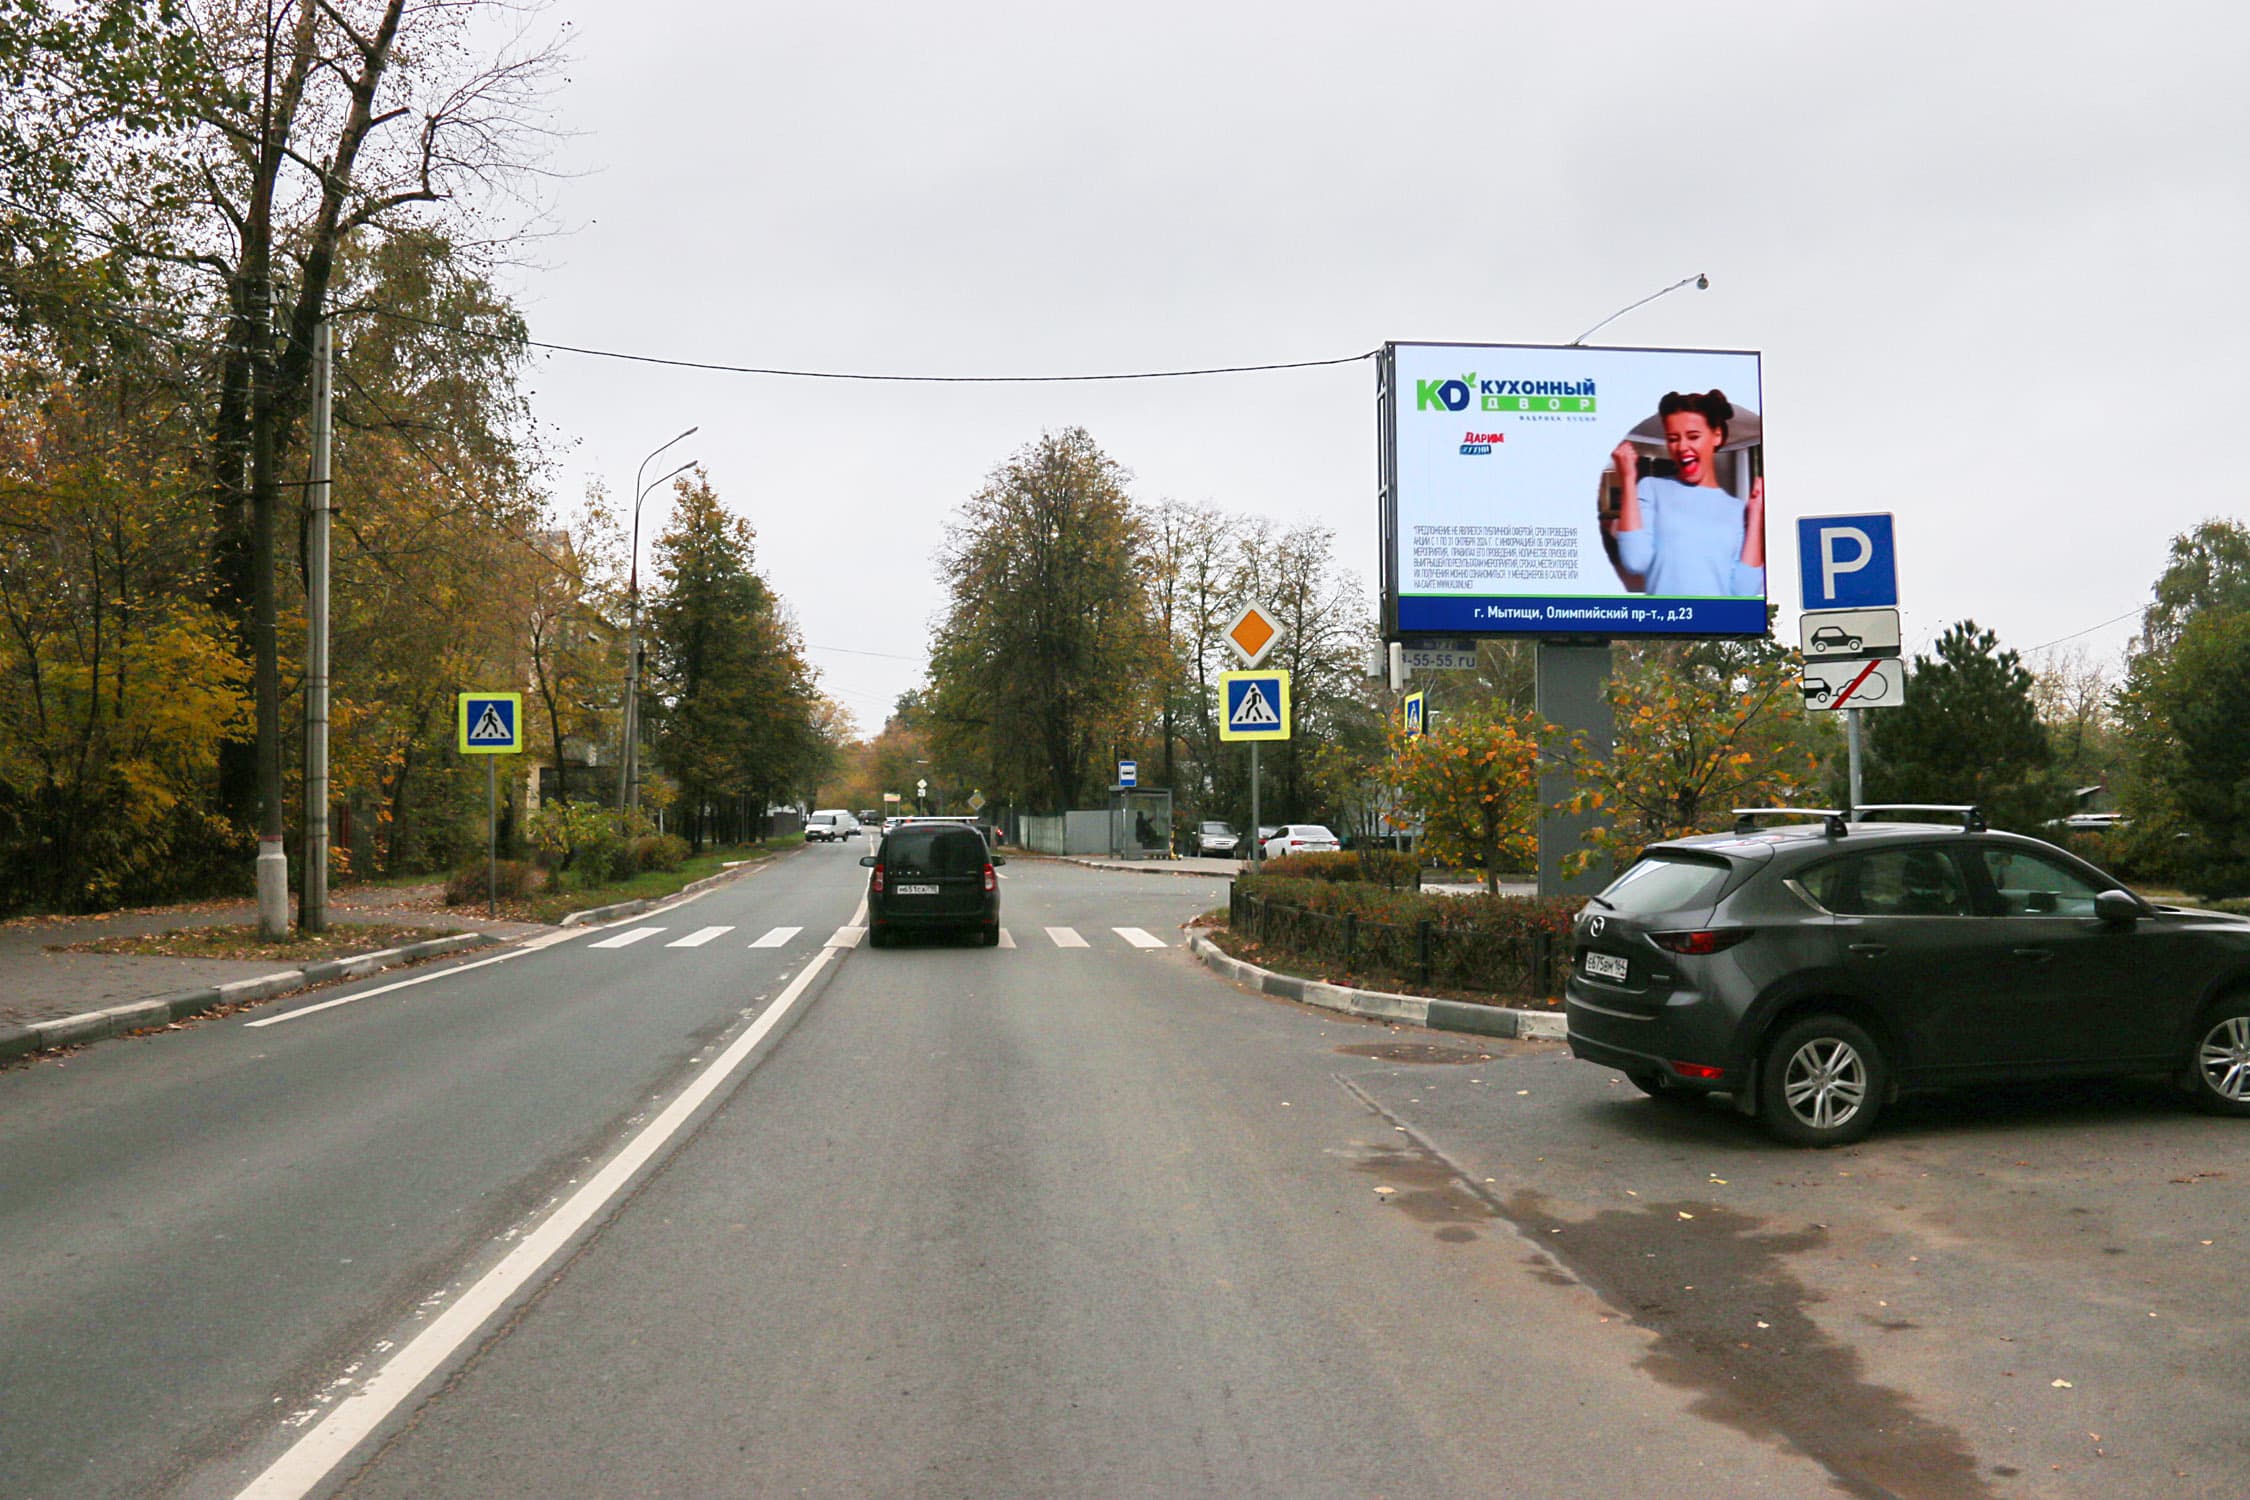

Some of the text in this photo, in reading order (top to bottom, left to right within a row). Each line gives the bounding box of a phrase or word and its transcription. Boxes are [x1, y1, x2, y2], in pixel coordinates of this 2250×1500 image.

[1480, 378, 1596, 396] КУХОННЫЙ
[1486, 397, 1591, 410] ДВОР
[1474, 606, 1693, 622] г. Мытищи, Олимпийский пр-т., д.23
